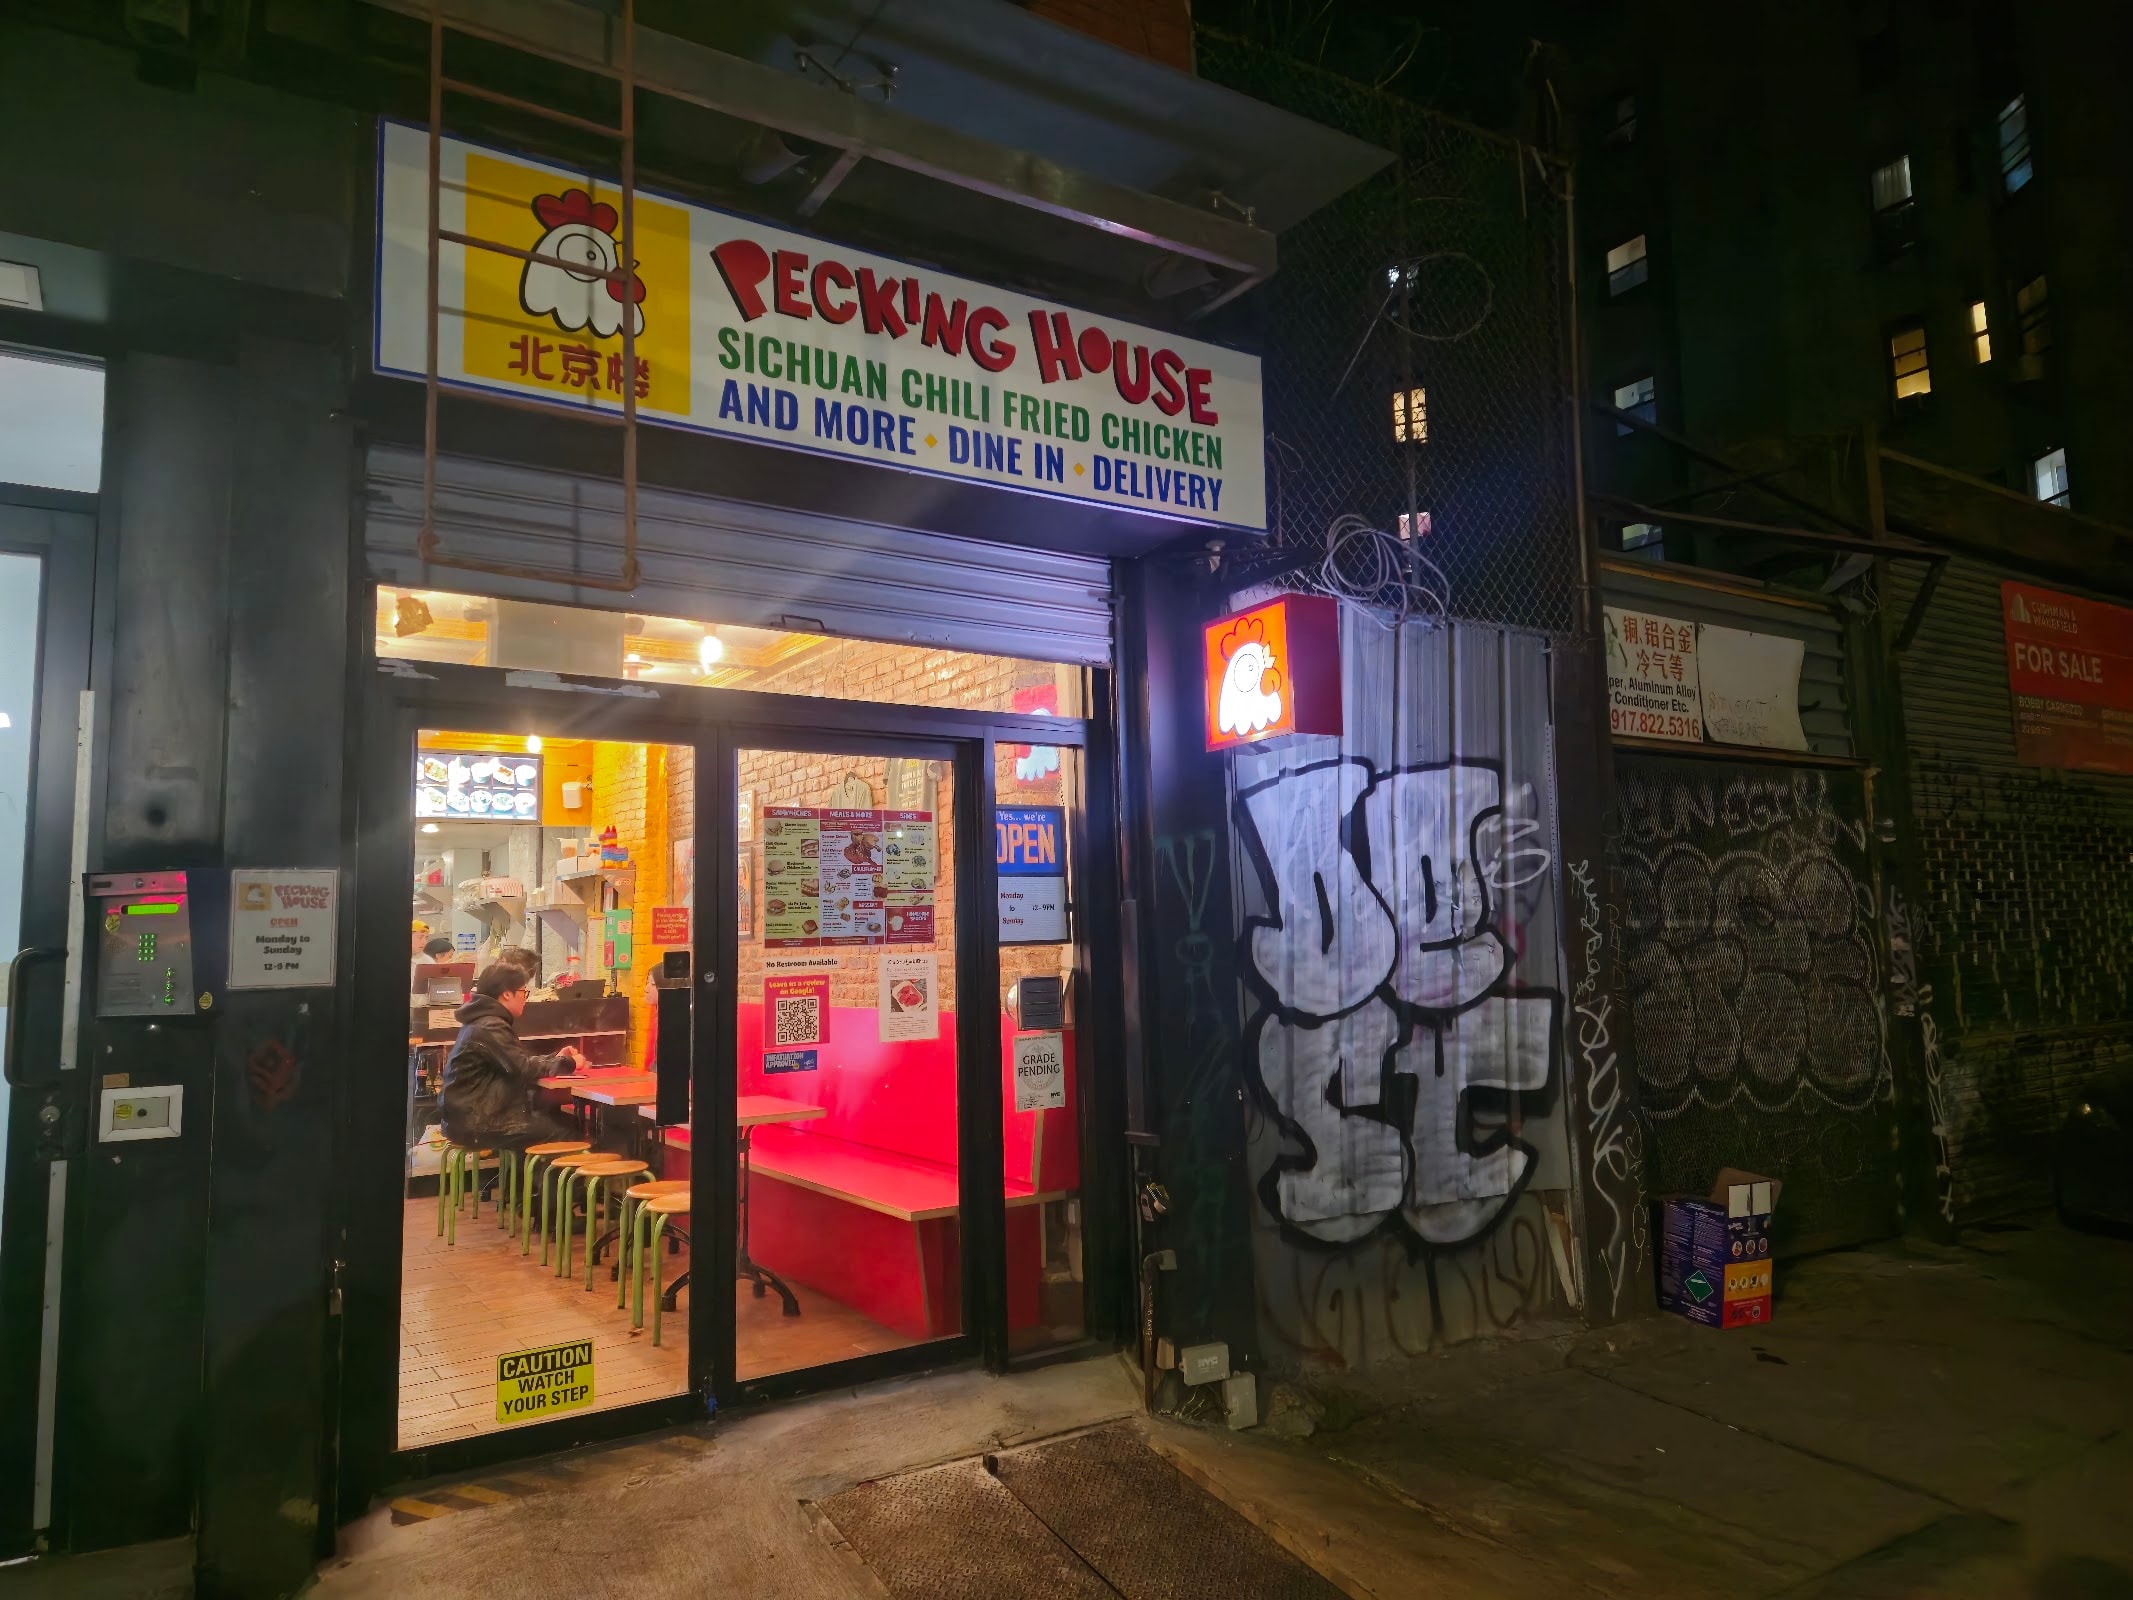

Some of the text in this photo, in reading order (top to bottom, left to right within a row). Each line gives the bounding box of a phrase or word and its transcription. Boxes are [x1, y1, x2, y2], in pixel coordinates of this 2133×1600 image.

[710, 239, 1219, 426] PECKING HOUSE
[718, 327, 1222, 470] SICHUAN CHILI FRIED CHICKEN
[718, 378, 1222, 511] AND MORE DINE IN DELIVERY
[2032, 615, 2078, 633] WAKEFIELD
[2014, 642, 2103, 683] FOR SALE
[1629, 678, 1674, 696] Aluminum
[1676, 684, 1697, 700] Alloy
[1614, 691, 1669, 710] Conditioner
[1671, 699, 1690, 713] Etc.
[1024, 812, 1046, 821] we're
[996, 823, 1056, 864] OPEN
[274, 885, 330, 898] PECKING
[281, 896, 328, 909] HOUSE
[256, 935, 310, 945] Monday to
[263, 946, 302, 955] Sunday
[1018, 1063, 1061, 1077] PENDING
[1023, 1053, 1056, 1065] GRADE
[503, 1345, 589, 1378] CAUTION
[518, 1370, 575, 1393] WATCH
[503, 1385, 589, 1414] YOUR STEP
